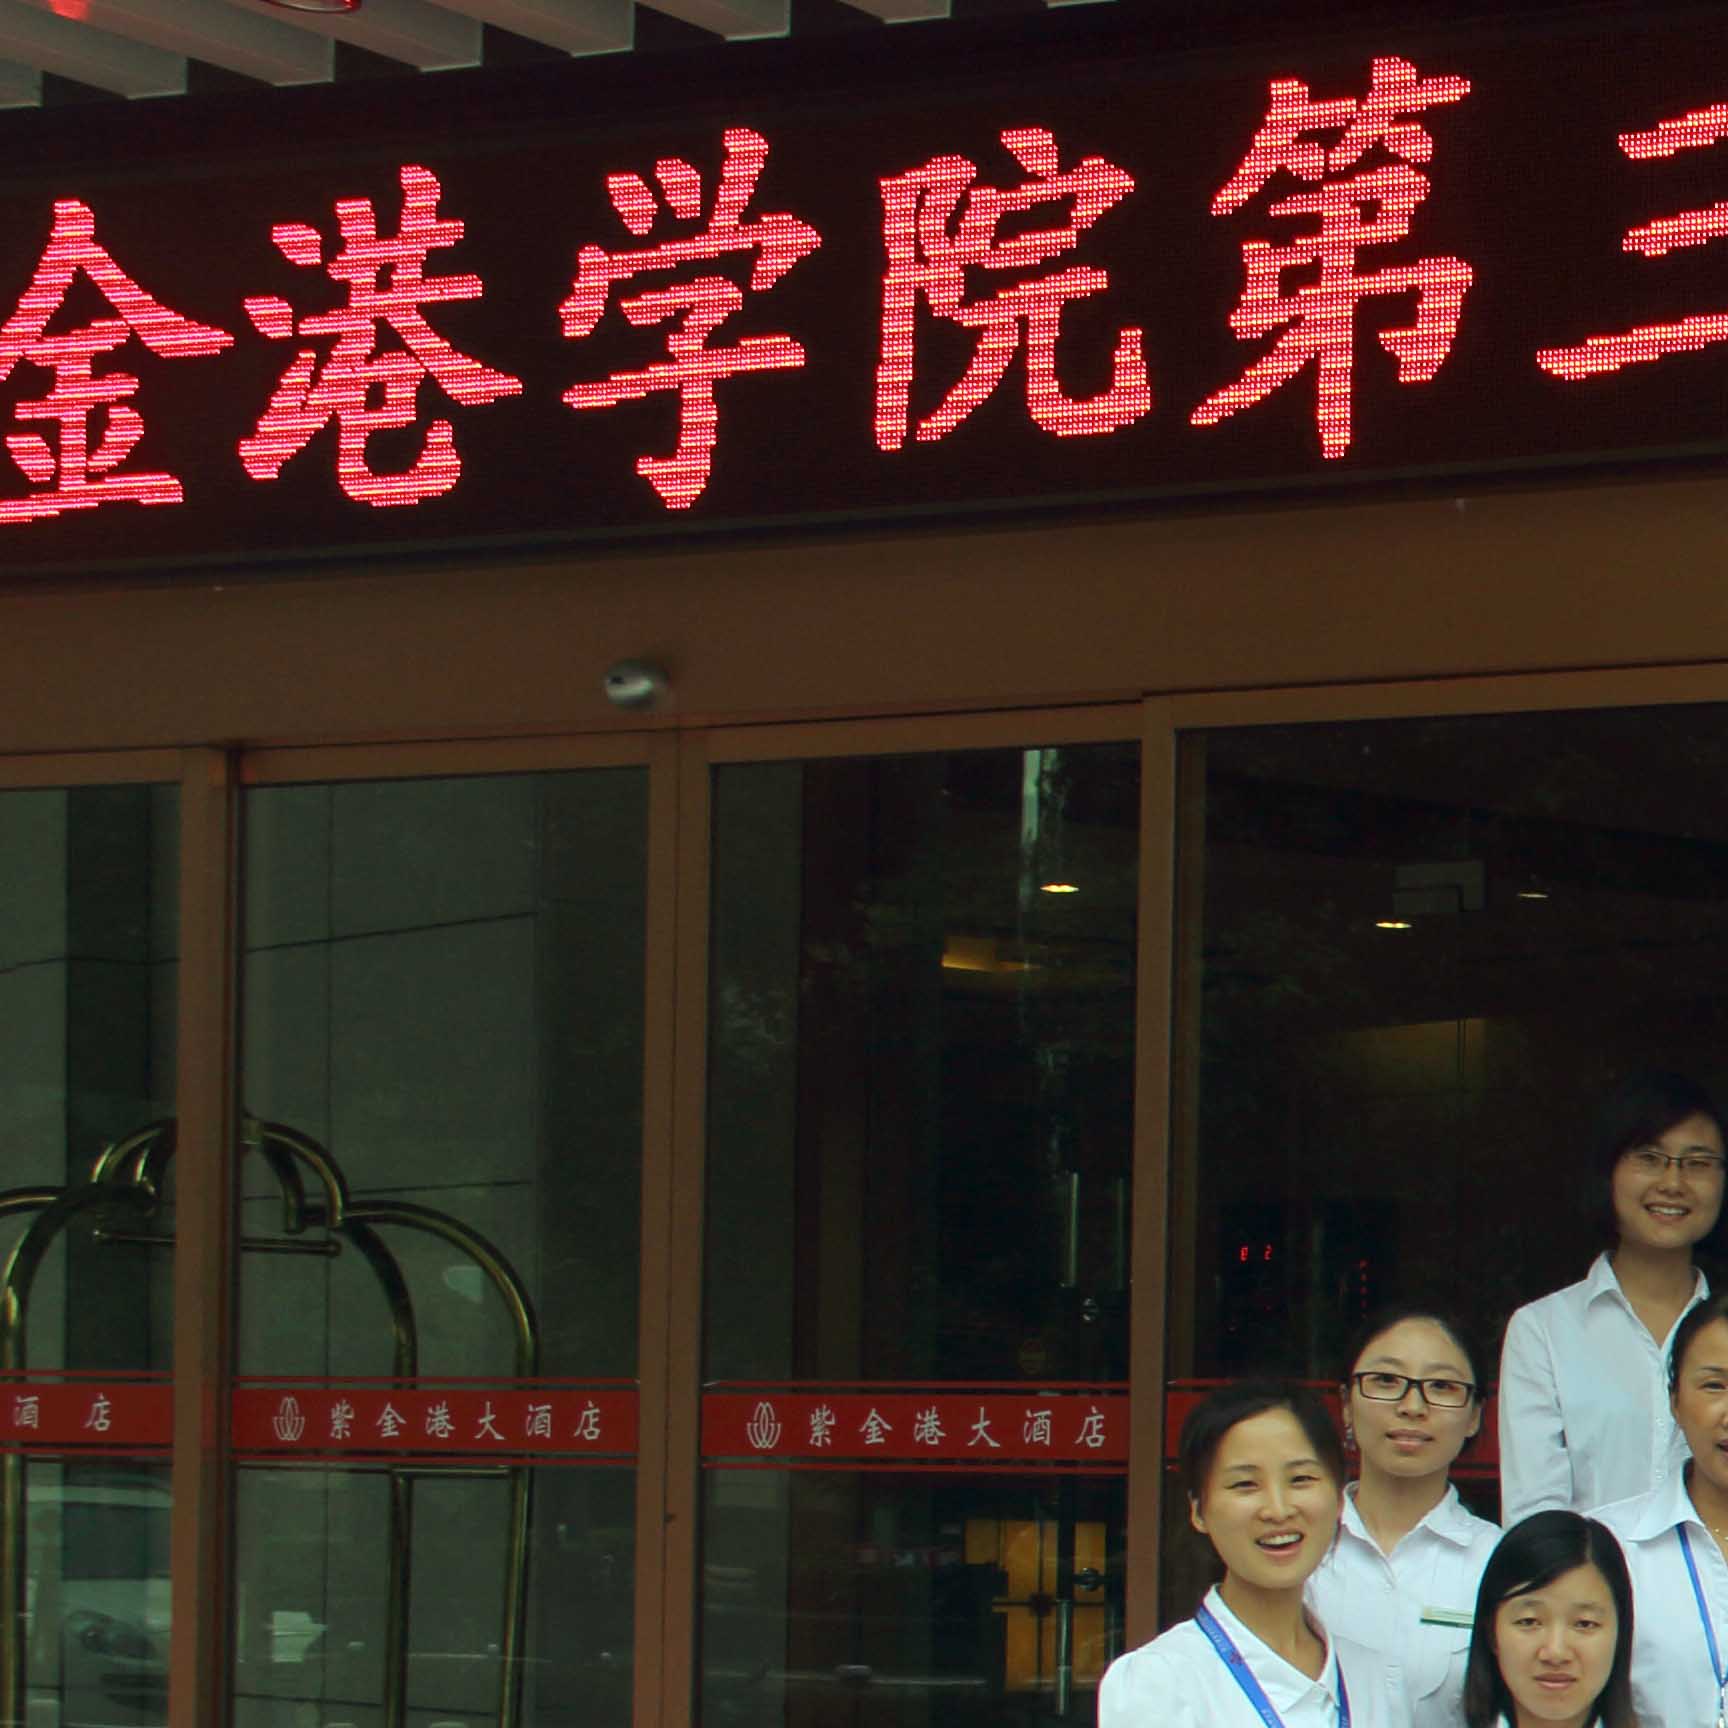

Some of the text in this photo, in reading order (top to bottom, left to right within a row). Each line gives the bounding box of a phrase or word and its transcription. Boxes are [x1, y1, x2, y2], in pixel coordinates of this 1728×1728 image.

[13, 1393, 112, 1433] 酒店
[329, 1400, 603, 1442] 紫金港大酒店
[807, 1404, 1107, 1449] 紫金港大酒店
